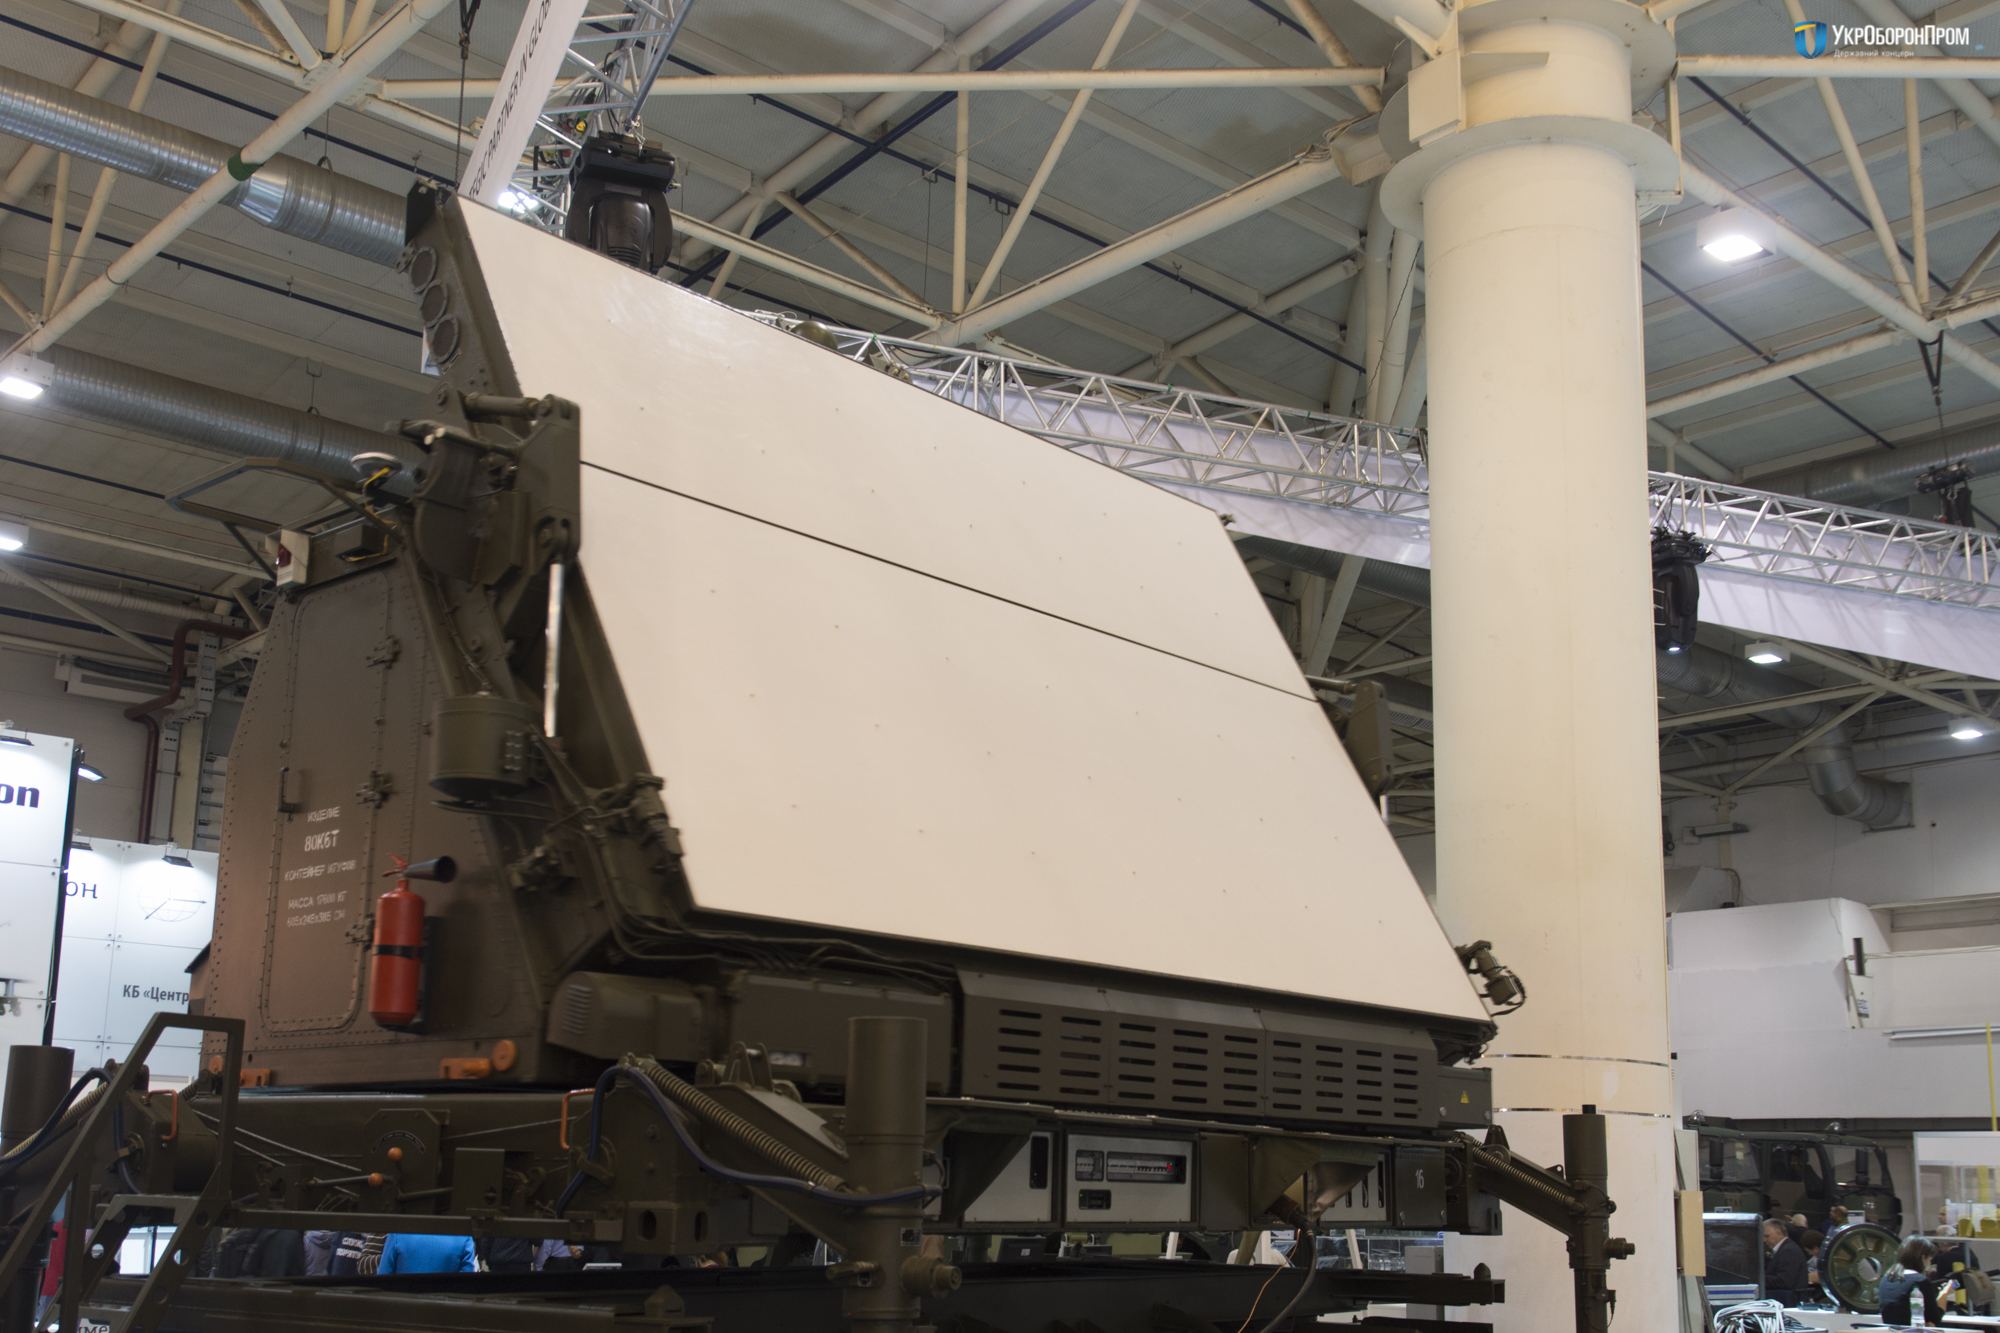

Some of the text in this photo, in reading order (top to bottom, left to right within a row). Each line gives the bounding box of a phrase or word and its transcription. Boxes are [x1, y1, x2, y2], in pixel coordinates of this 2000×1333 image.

[487, 71, 519, 168] PARTNER
[519, 44, 528, 87] IN
[529, 0, 551, 58] GLOB
[123, 984, 189, 1005] КБ «Центр
[1415, 1169, 1425, 1189] 16
